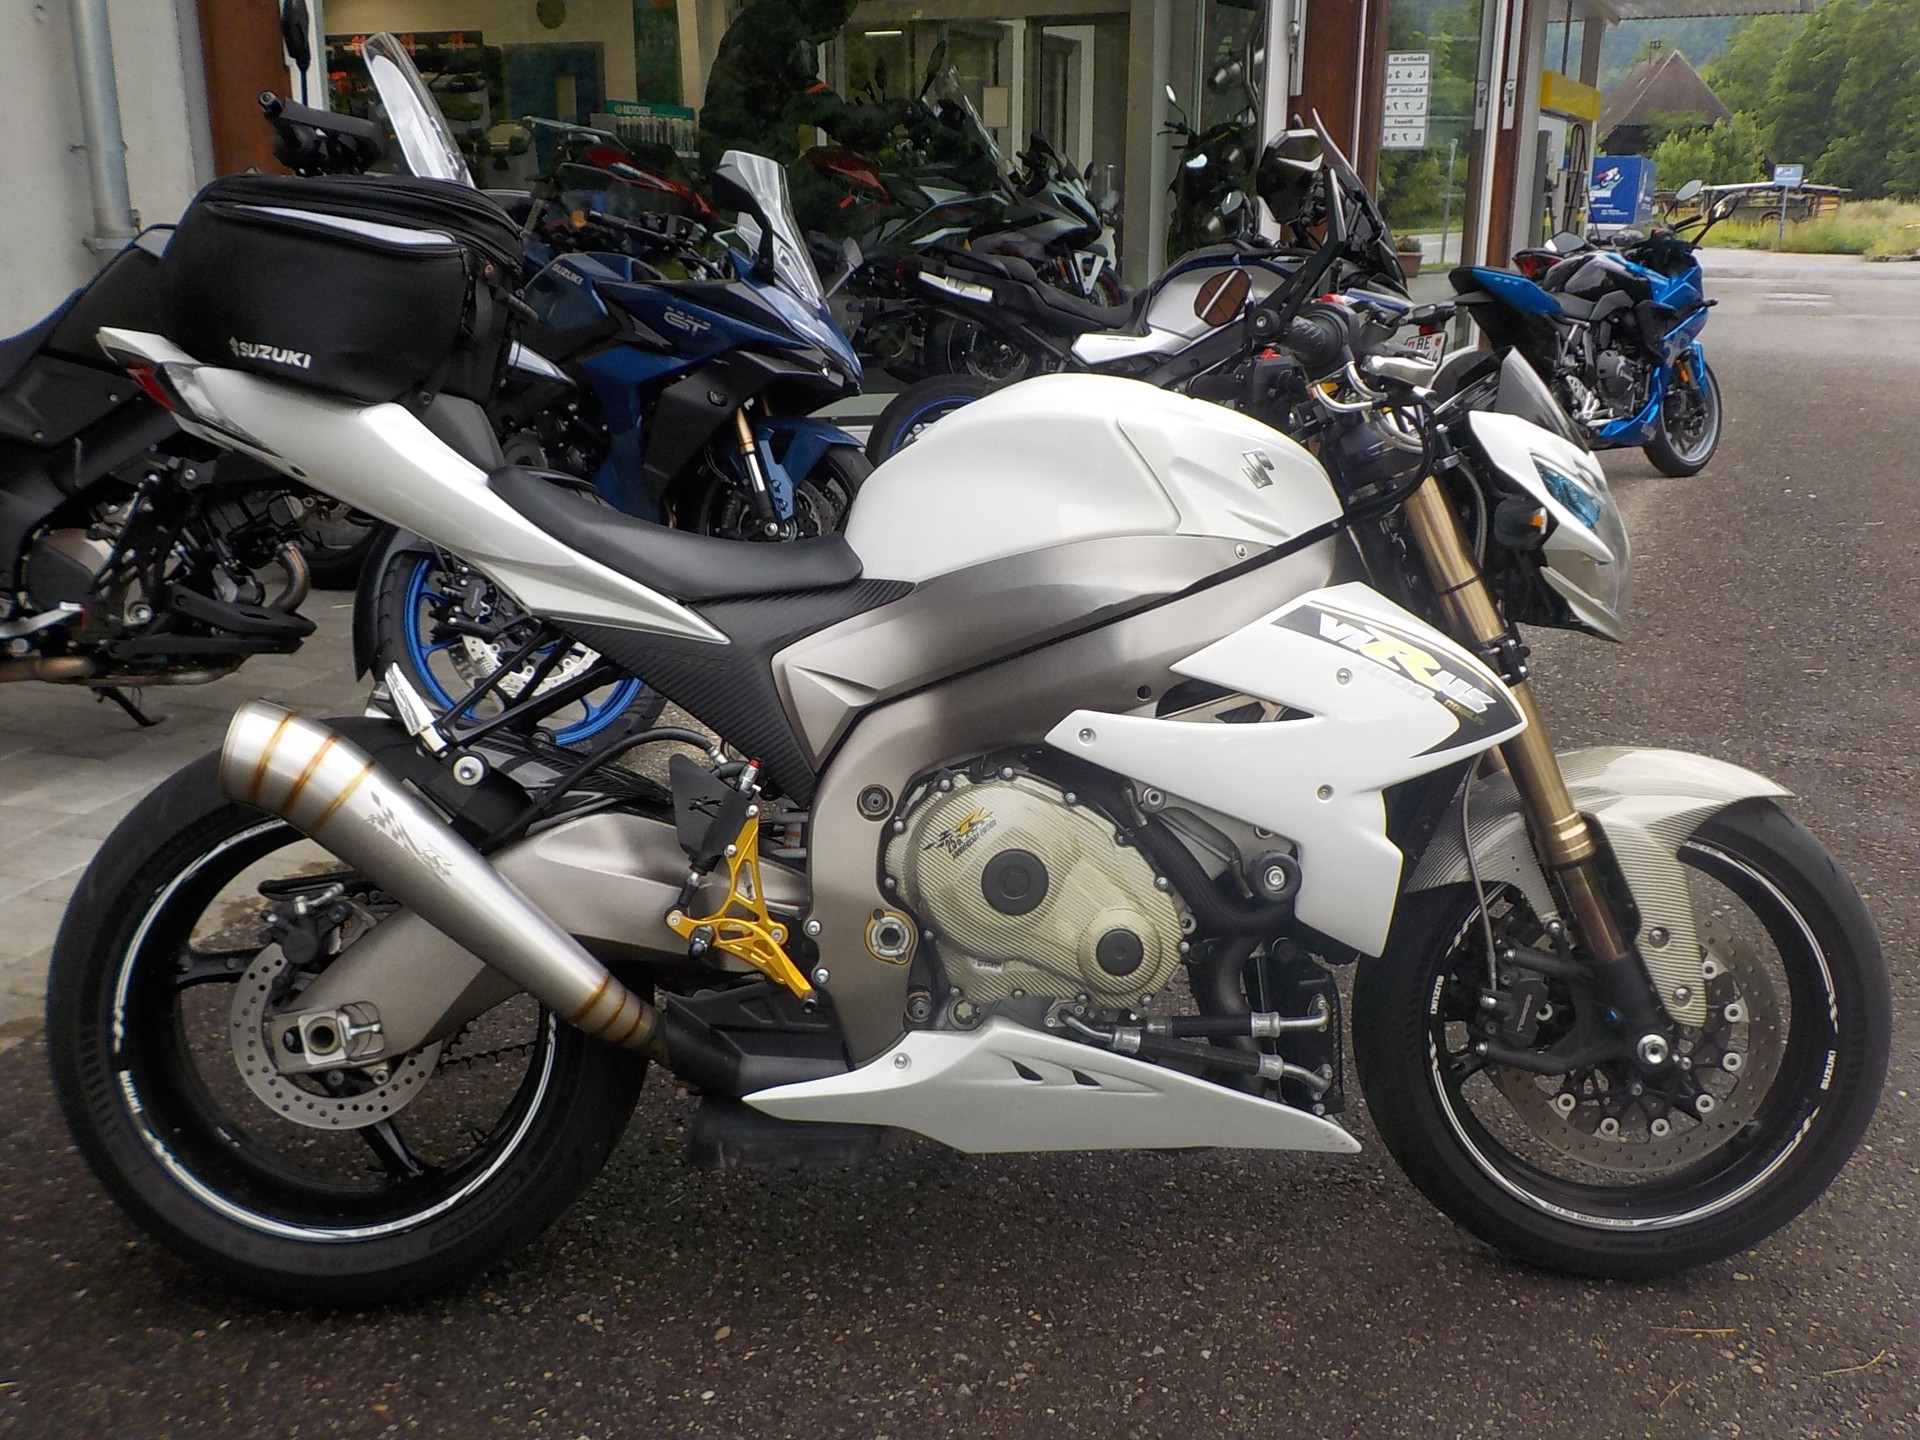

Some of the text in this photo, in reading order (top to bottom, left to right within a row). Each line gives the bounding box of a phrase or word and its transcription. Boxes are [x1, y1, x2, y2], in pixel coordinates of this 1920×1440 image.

[551, 263, 584, 286] SUZUKI
[239, 341, 312, 369] SUZUKI
[1416, 336, 1432, 350] BE
[1430, 975, 1445, 1015] SUZUKI
[1820, 1050, 1837, 1090] SUZUKI
